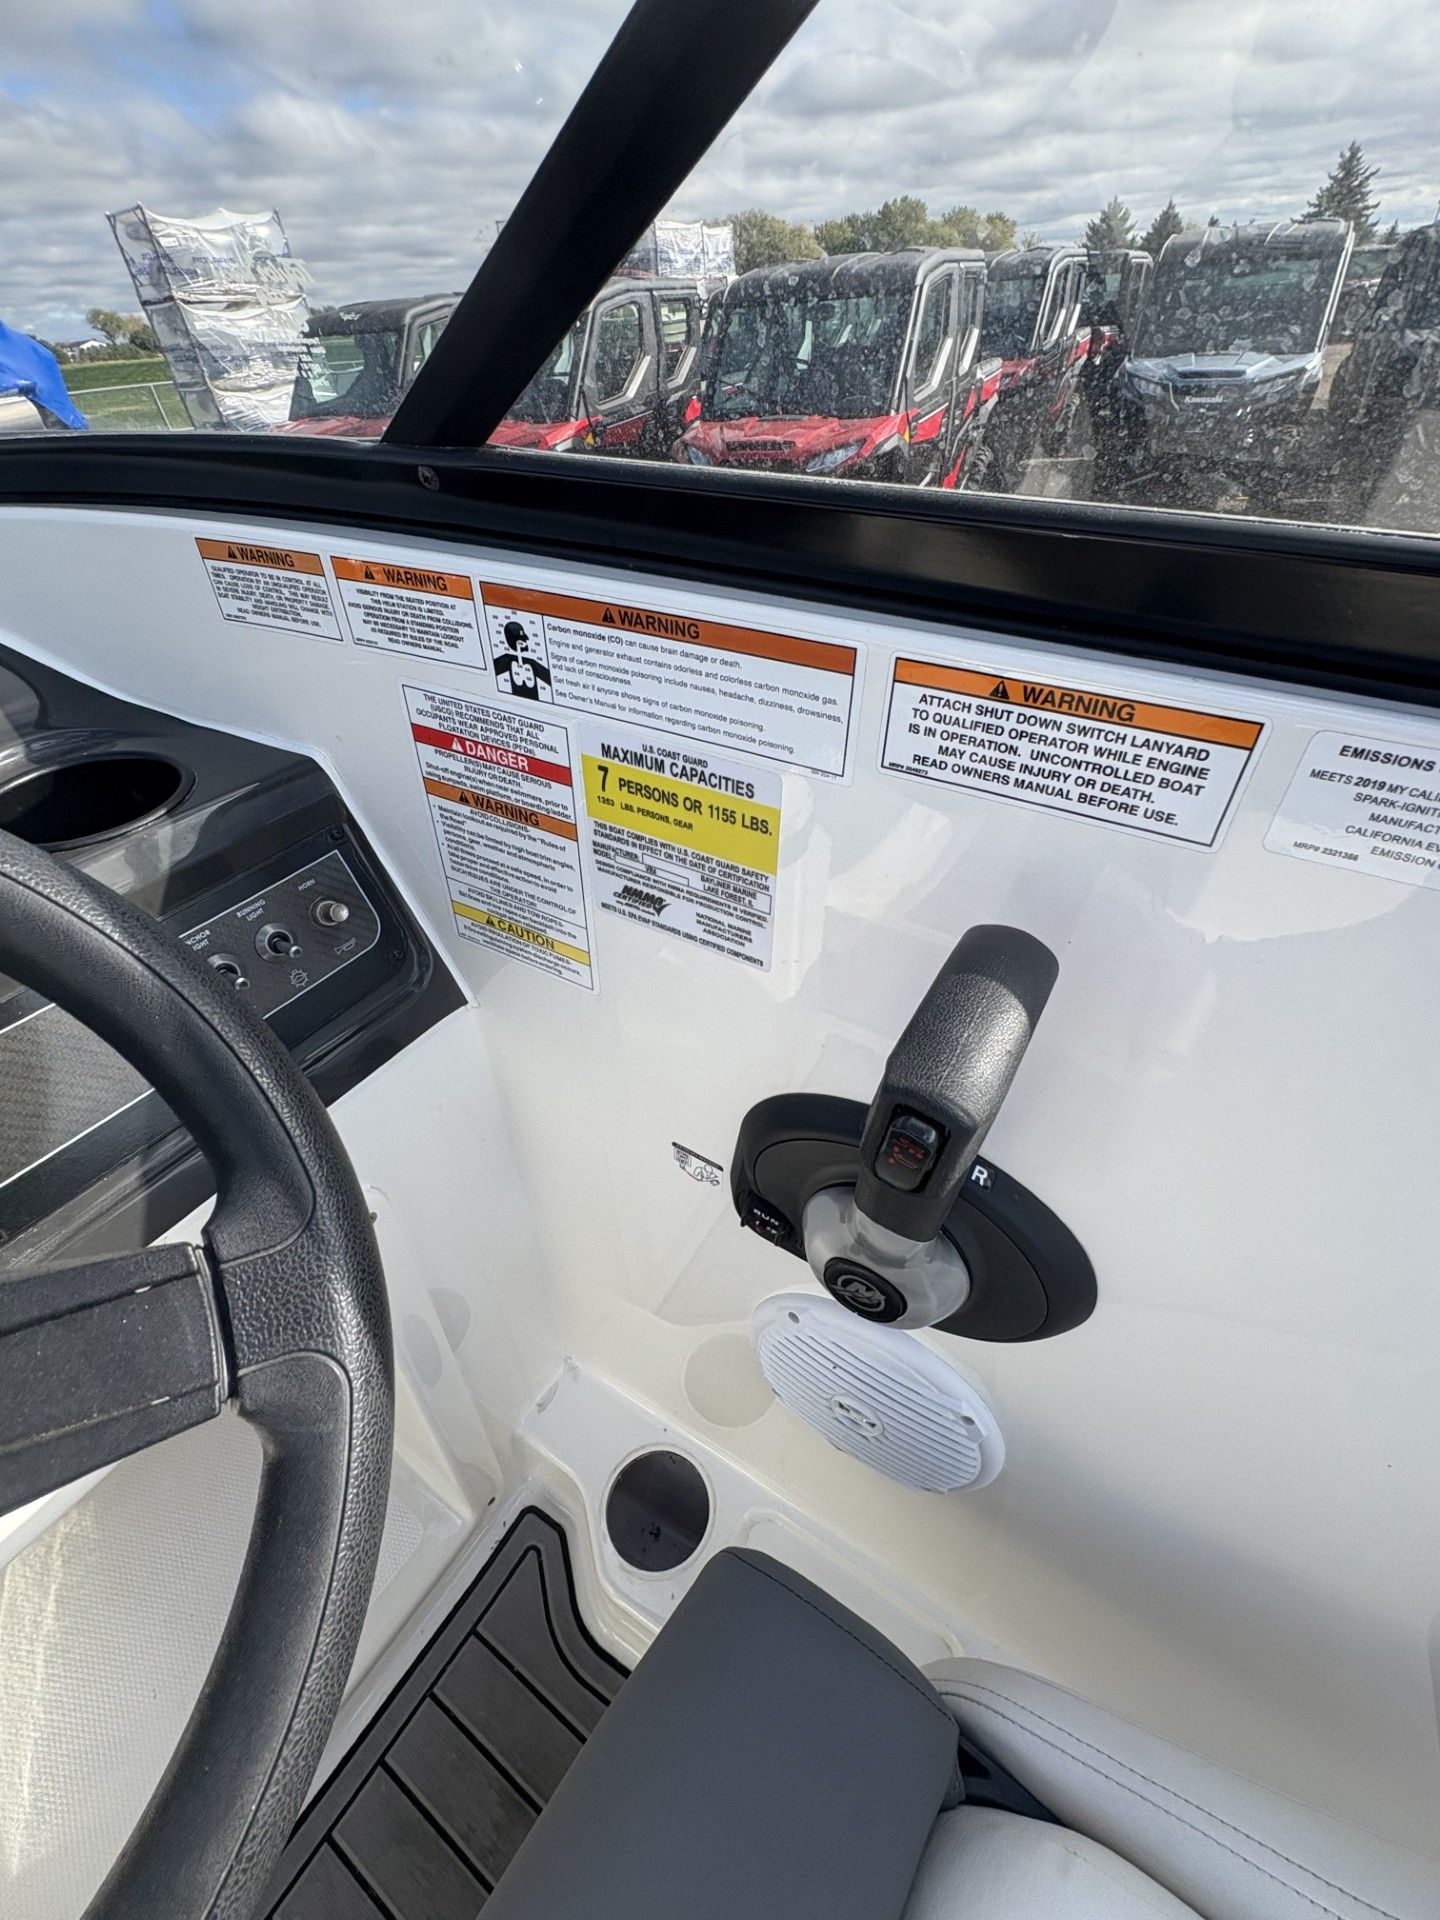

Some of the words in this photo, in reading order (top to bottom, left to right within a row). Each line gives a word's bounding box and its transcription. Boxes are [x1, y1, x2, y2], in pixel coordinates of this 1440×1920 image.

[1184, 395, 1223, 403] Kawasaki
[235, 546, 295, 568] WARNING
[382, 567, 448, 591] WARNING
[618, 609, 699, 640] WARNING
[546, 622, 571, 635] Carbon
[571, 627, 606, 642] monoxide
[606, 633, 624, 647] (CO)
[624, 639, 637, 648] can
[638, 642, 659, 652] cause
[660, 645, 677, 656] brain
[679, 649, 708, 664] damage
[710, 656, 717, 664] or
[719, 657, 742, 669] death.
[548, 636, 570, 650] Engine
[570, 641, 583, 651] and
[584, 645, 615, 660] generator
[615, 651, 642, 664] exhaust
[643, 657, 672, 670] contains
[673, 663, 703, 677] odorless
[704, 670, 718, 680] and
[719, 673, 752, 687] colorless
[753, 680, 780, 693] carbon
[781, 687, 820, 702] monoxide
[551, 661, 563, 671] and
[563, 664, 576, 673] lack
[576, 666, 584, 675] of
[549, 651, 568, 663] Signs
[567, 655, 575, 664] of
[575, 657, 597, 669] carbon
[598, 662, 630, 675] monoxide
[630, 669, 662, 684] poisoning
[663, 676, 688, 688] include
[718, 688, 756, 704] headache,
[757, 697, 795, 712] dizziness,
[796, 705, 844, 723] drowsiness,
[552, 674, 564, 685] Get
[565, 677, 581, 688] fresh
[596, 685, 620, 698] anyone
[620, 690, 641, 702] shows
[642, 695, 660, 708] signs
[660, 699, 668, 708] of
[668, 701, 692, 714] carbon
[693, 708, 727, 723] monoxide
[728, 717, 765, 733] poisoning.
[1020, 684, 1137, 723] WARNING
[422, 692, 437, 703] THE
[437, 696, 463, 711] UNITED
[463, 703, 491, 718] STATES
[491, 711, 516, 725] COAST
[517, 718, 544, 732] GUARD
[454, 709, 505, 730] RECOMMENDS
[505, 723, 524, 735] THAT
[525, 729, 539, 740] ALL
[554, 688, 567, 699] See
[593, 697, 617, 710] Manual
[617, 703, 626, 712] for
[627, 705, 663, 721] information
[664, 715, 696, 731] regarding
[697, 722, 721, 735] carbon
[722, 729, 756, 744] monoxide
[758, 738, 794, 755] poisoning.
[918, 692, 972, 714] ATTACH
[974, 703, 1014, 722] SHUT
[1015, 712, 1063, 732] DOWN
[1065, 722, 1127, 745] SWITCH
[1129, 735, 1211, 762] LANYARD
[415, 707, 457, 725] OCCUPANTS
[456, 718, 478, 731] WEAR
[478, 724, 518, 743] APPROVED
[518, 735, 559, 754] PERSONAL
[437, 721, 480, 740] FLOATATION
[480, 733, 511, 749] DEVICES
[911, 707, 929, 721] TO
[931, 711, 1005, 737] QUALIFIED
[1007, 727, 1089, 755] OPERATOR
[1091, 745, 1143, 766] WHILE
[1145, 756, 1211, 780] ENGINE
[464, 739, 529, 772] DANGER
[600, 742, 665, 774] MAXIMUM
[669, 761, 754, 799] CAPACITIES
[641, 743, 654, 754] U.S.
[656, 746, 680, 761] COAST
[681, 753, 708, 769] GUARD
[908, 722, 921, 735] IS
[923, 725, 937, 738] IN
[939, 729, 1022, 757] OPERATION.
[1029, 748, 1156, 786] UNCONTROLLED
[1157, 776, 1204, 797] BOAT
[1339, 745, 1436, 772] EMISSIONS
[912, 753, 948, 771] READ
[950, 762, 1011, 786] OWNERS
[1012, 777, 1075, 801] MANUAL
[1076, 792, 1140, 816] BEFORE
[1141, 807, 1181, 826] USE.
[937, 744, 966, 760] MAY
[968, 751, 1016, 772] CAUSE
[1018, 762, 1071, 784] INJURY
[1073, 774, 1097, 790] OR
[1098, 780, 1157, 804] DEATH.
[1309, 769, 1353, 785] MEETS
[1354, 776, 1387, 791] 2019
[1386, 784, 1409, 795] MY
[471, 793, 539, 827] WARNING
[597, 764, 610, 793] 7
[618, 776, 679, 808] PERSONS
[682, 795, 702, 815] OR
[708, 803, 736, 825] 1155
[741, 813, 773, 836] LBS.
[620, 801, 635, 813] LBS.
[636, 806, 671, 824] PERSONS,
[672, 817, 693, 831] GEAR
[593, 820, 607, 831] THIS
[608, 824, 625, 837] BOAT
[626, 830, 658, 847] COMPLIES
[659, 840, 675, 852] WITH
[676, 846, 689, 857] U.S.
[691, 850, 714, 865] COAST
[715, 858, 739, 873] GUARD
[741, 867, 768, 883] SAFETY
[1345, 825, 1423, 849] CALIFORNIA
[593, 828, 630, 847] STANDARDS
[638, 842, 662, 857] EFFECT
[663, 850, 673, 861] ON
[674, 854, 687, 865] THE
[688, 859, 705, 871] DATE
[707, 865, 716, 875] OF
[717, 868, 769, 892] CERTIFICATION
[1369, 845, 1436, 868] EMISSION
[297, 879, 316, 891] HORN
[236, 899, 266, 918] RUNNING
[246, 908, 264, 921] LIGHT
[496, 918, 554, 950] CAUTION
[971, 1165, 989, 1186] R
